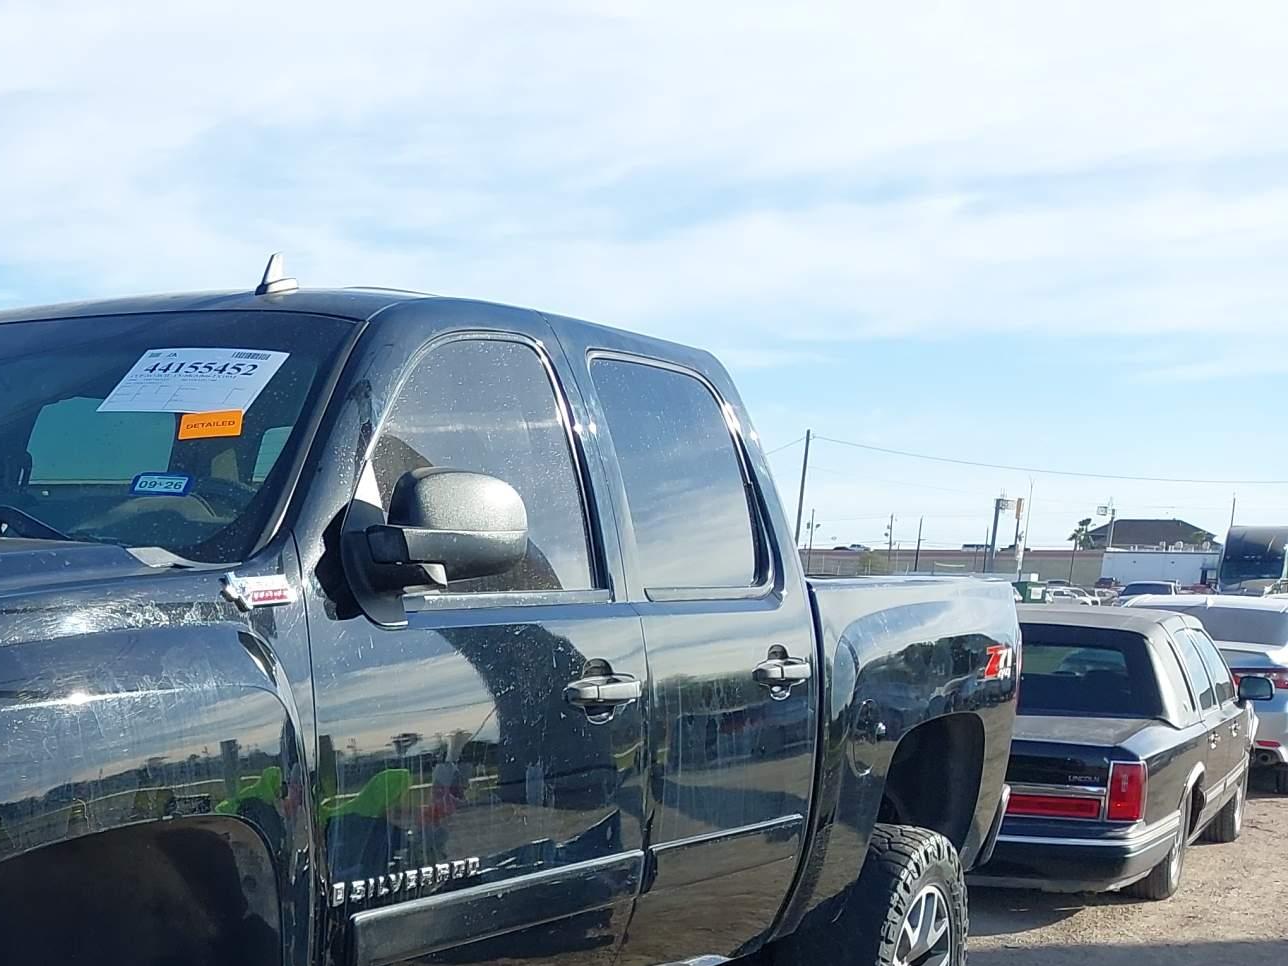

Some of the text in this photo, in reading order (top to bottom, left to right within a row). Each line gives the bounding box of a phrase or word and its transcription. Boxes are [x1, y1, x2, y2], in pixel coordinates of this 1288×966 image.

[144, 361, 259, 376] 44155452
[185, 420, 236, 430] DETAILED
[349, 856, 480, 901] SILVERADO
